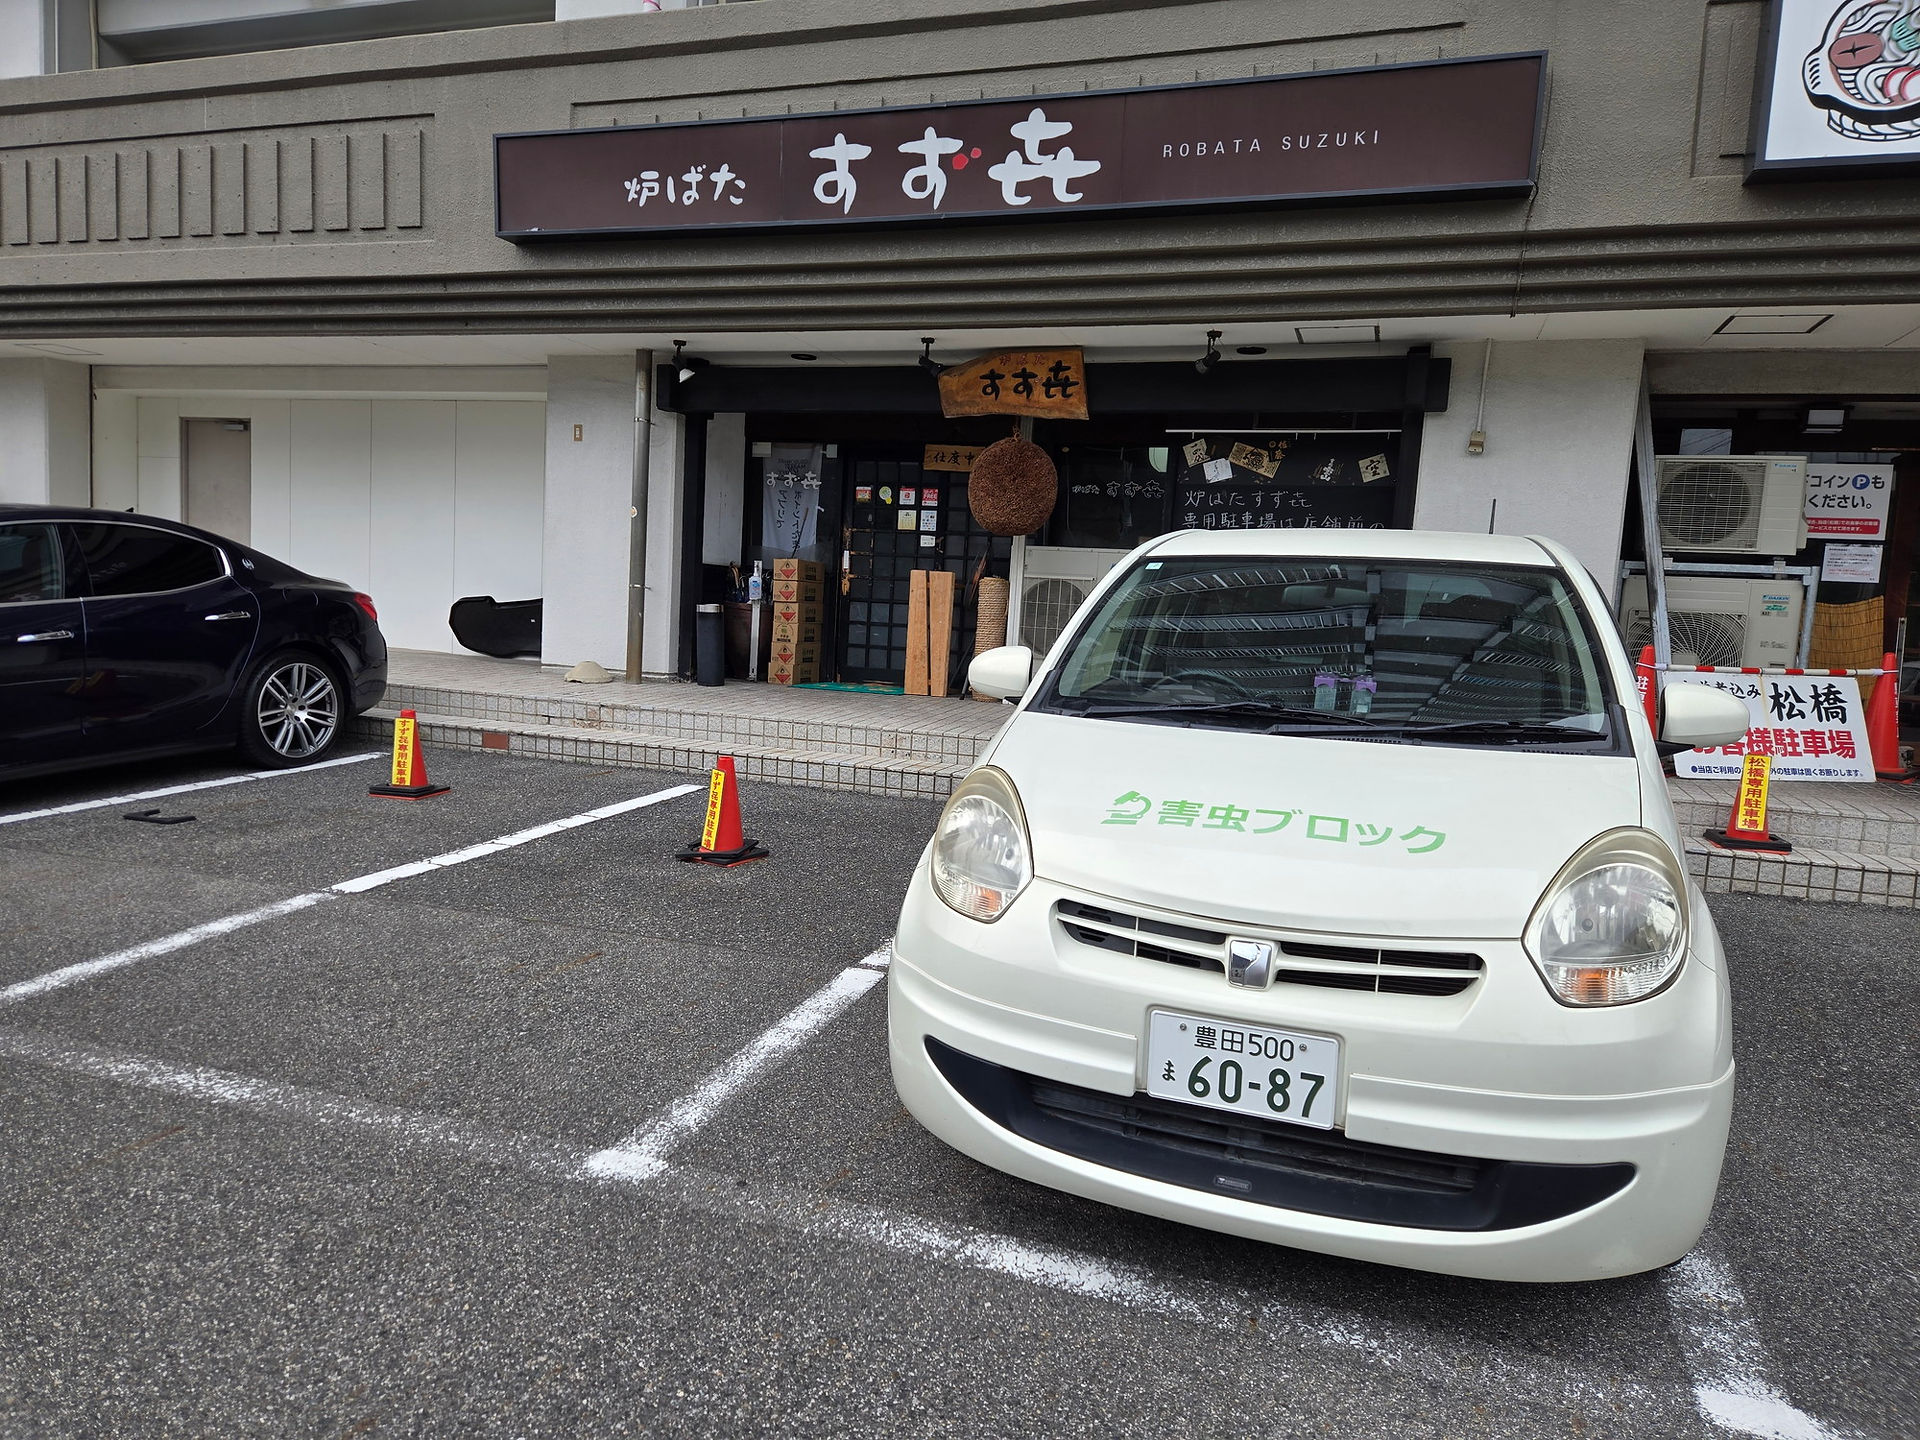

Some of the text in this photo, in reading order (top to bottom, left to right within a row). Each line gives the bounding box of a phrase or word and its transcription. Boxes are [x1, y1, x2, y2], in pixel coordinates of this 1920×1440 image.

[1162, 129, 1379, 158] ROBATA SUZUKI
[624, 163, 746, 207] 炉ばた
[1769, 682, 1848, 724] 松橋
[1742, 757, 1766, 829] 松橋専用駐車場
[1157, 799, 1447, 854] 害虫ブロック
[1161, 1055, 1326, 1118] ま 60-87
